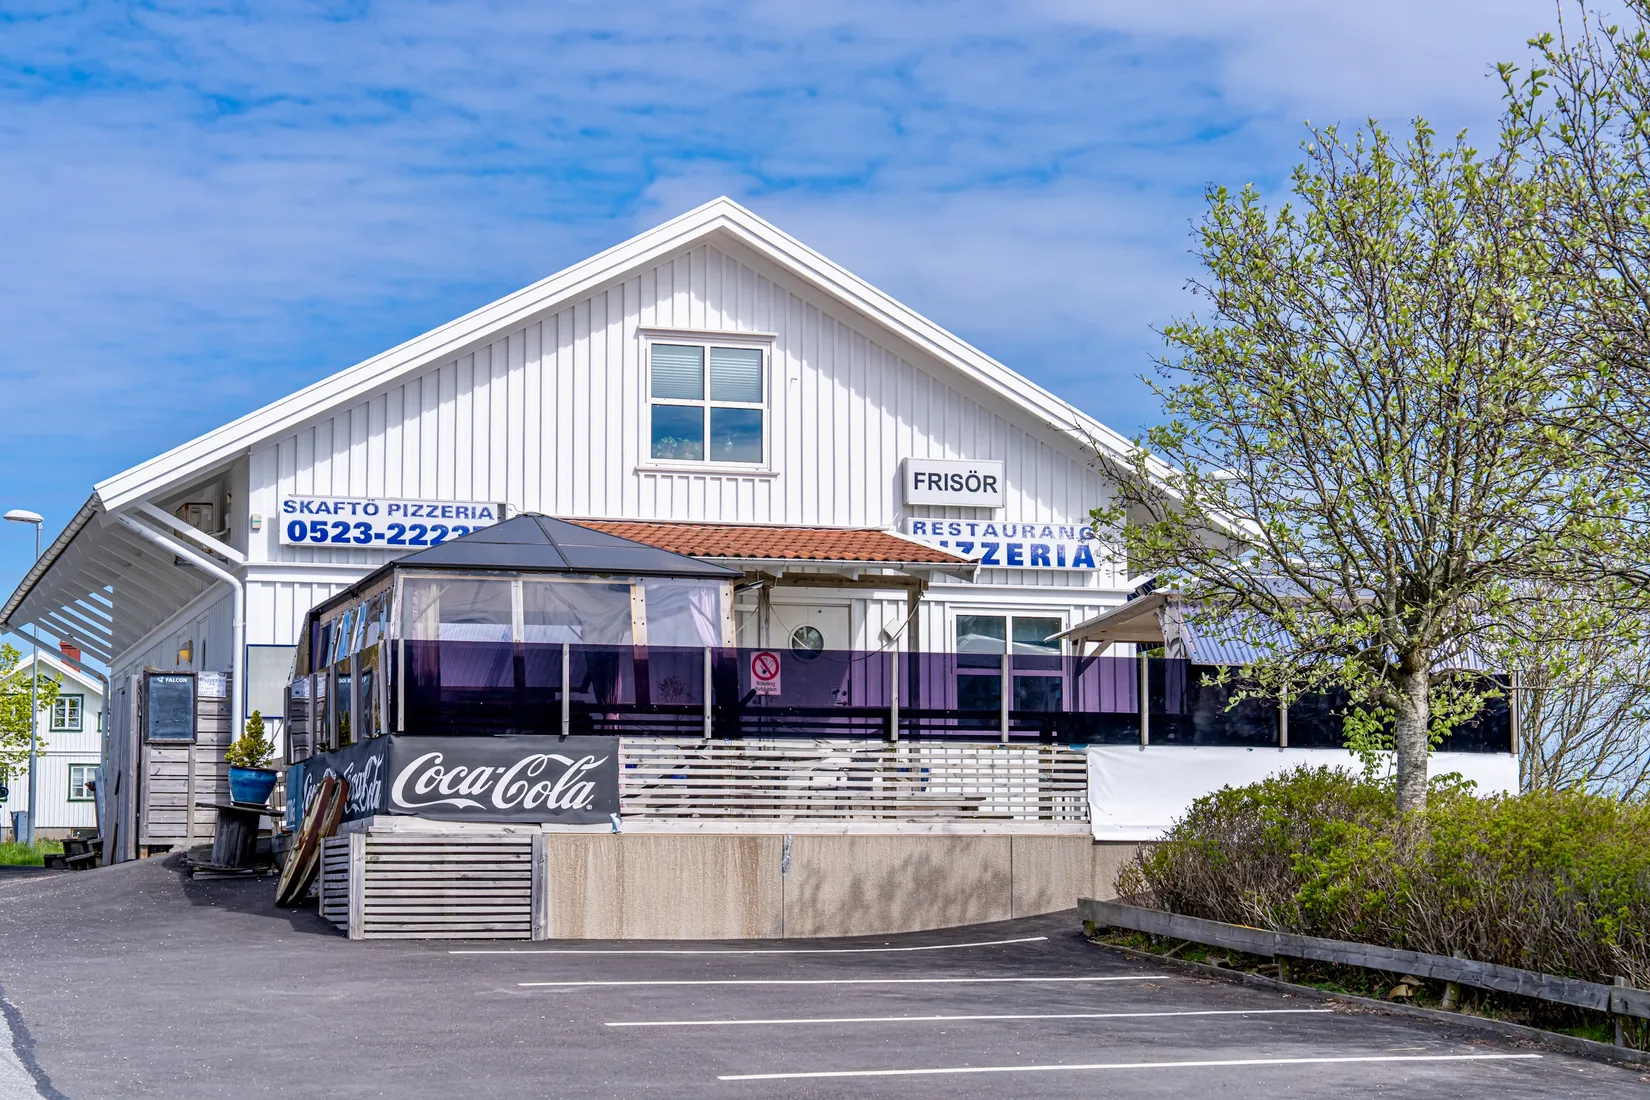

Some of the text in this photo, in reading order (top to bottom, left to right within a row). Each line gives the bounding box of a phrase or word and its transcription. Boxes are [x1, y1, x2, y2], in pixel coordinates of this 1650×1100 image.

[913, 470, 998, 494] FRISÖR
[283, 499, 495, 520] SKAFTÖ PIZZERIA
[912, 521, 1095, 541] RESTAURANG
[391, 751, 609, 810] Coca-Cola
